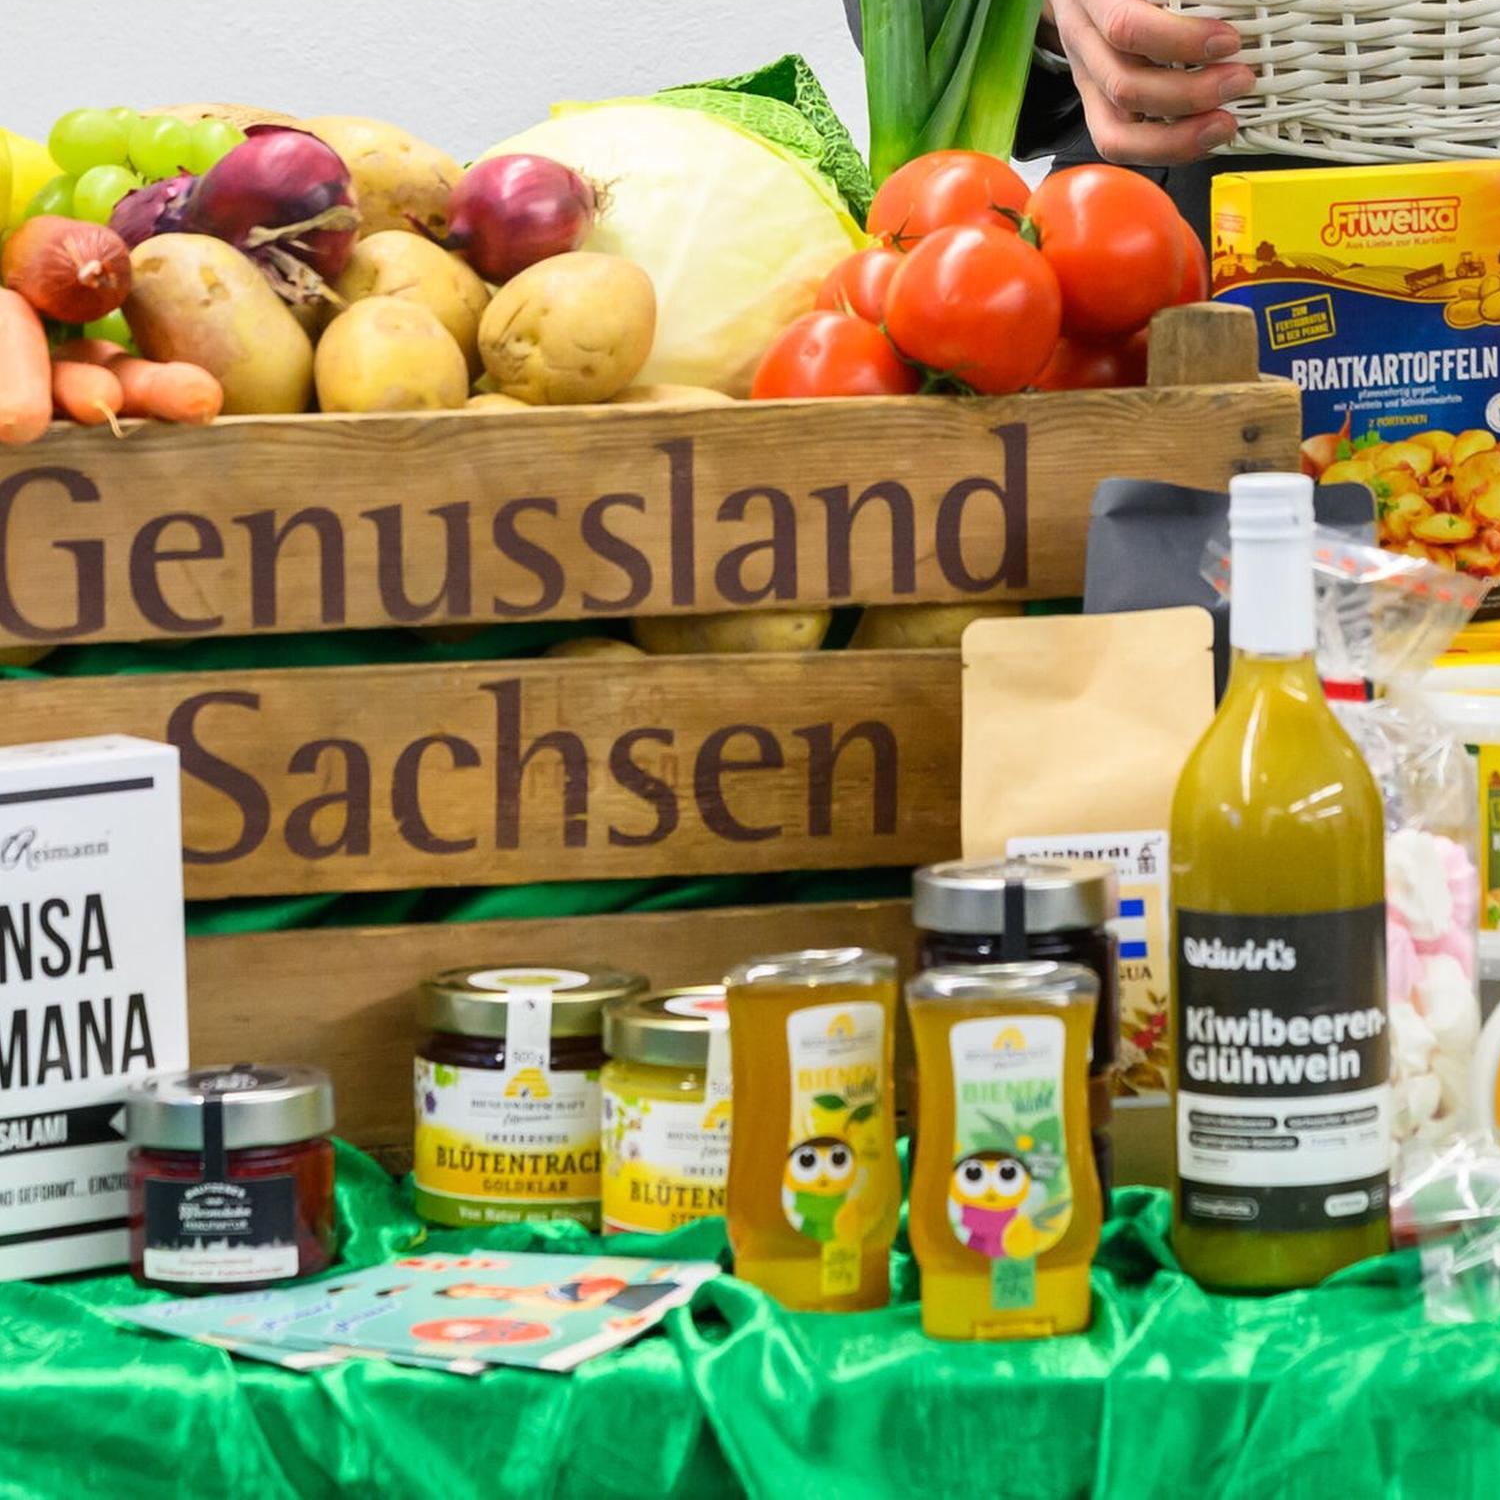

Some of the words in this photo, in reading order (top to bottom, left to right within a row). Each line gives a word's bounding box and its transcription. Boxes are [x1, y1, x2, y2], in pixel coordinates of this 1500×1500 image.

[1321, 196, 1461, 247] Friweika
[1291, 346, 1499, 392] BRATKARTOFFELN
[0, 423, 1030, 643] Genussland
[165, 678, 898, 866] Sachsen
[0, 893, 113, 984] NSA
[0, 993, 156, 1090] MANA
[1186, 1043, 1361, 1085] Glühwein
[0, 1114, 68, 1148] SALAMI
[482, 1178, 569, 1194] GOLDKLAR
[630, 1178, 726, 1209] BLÜTEN
